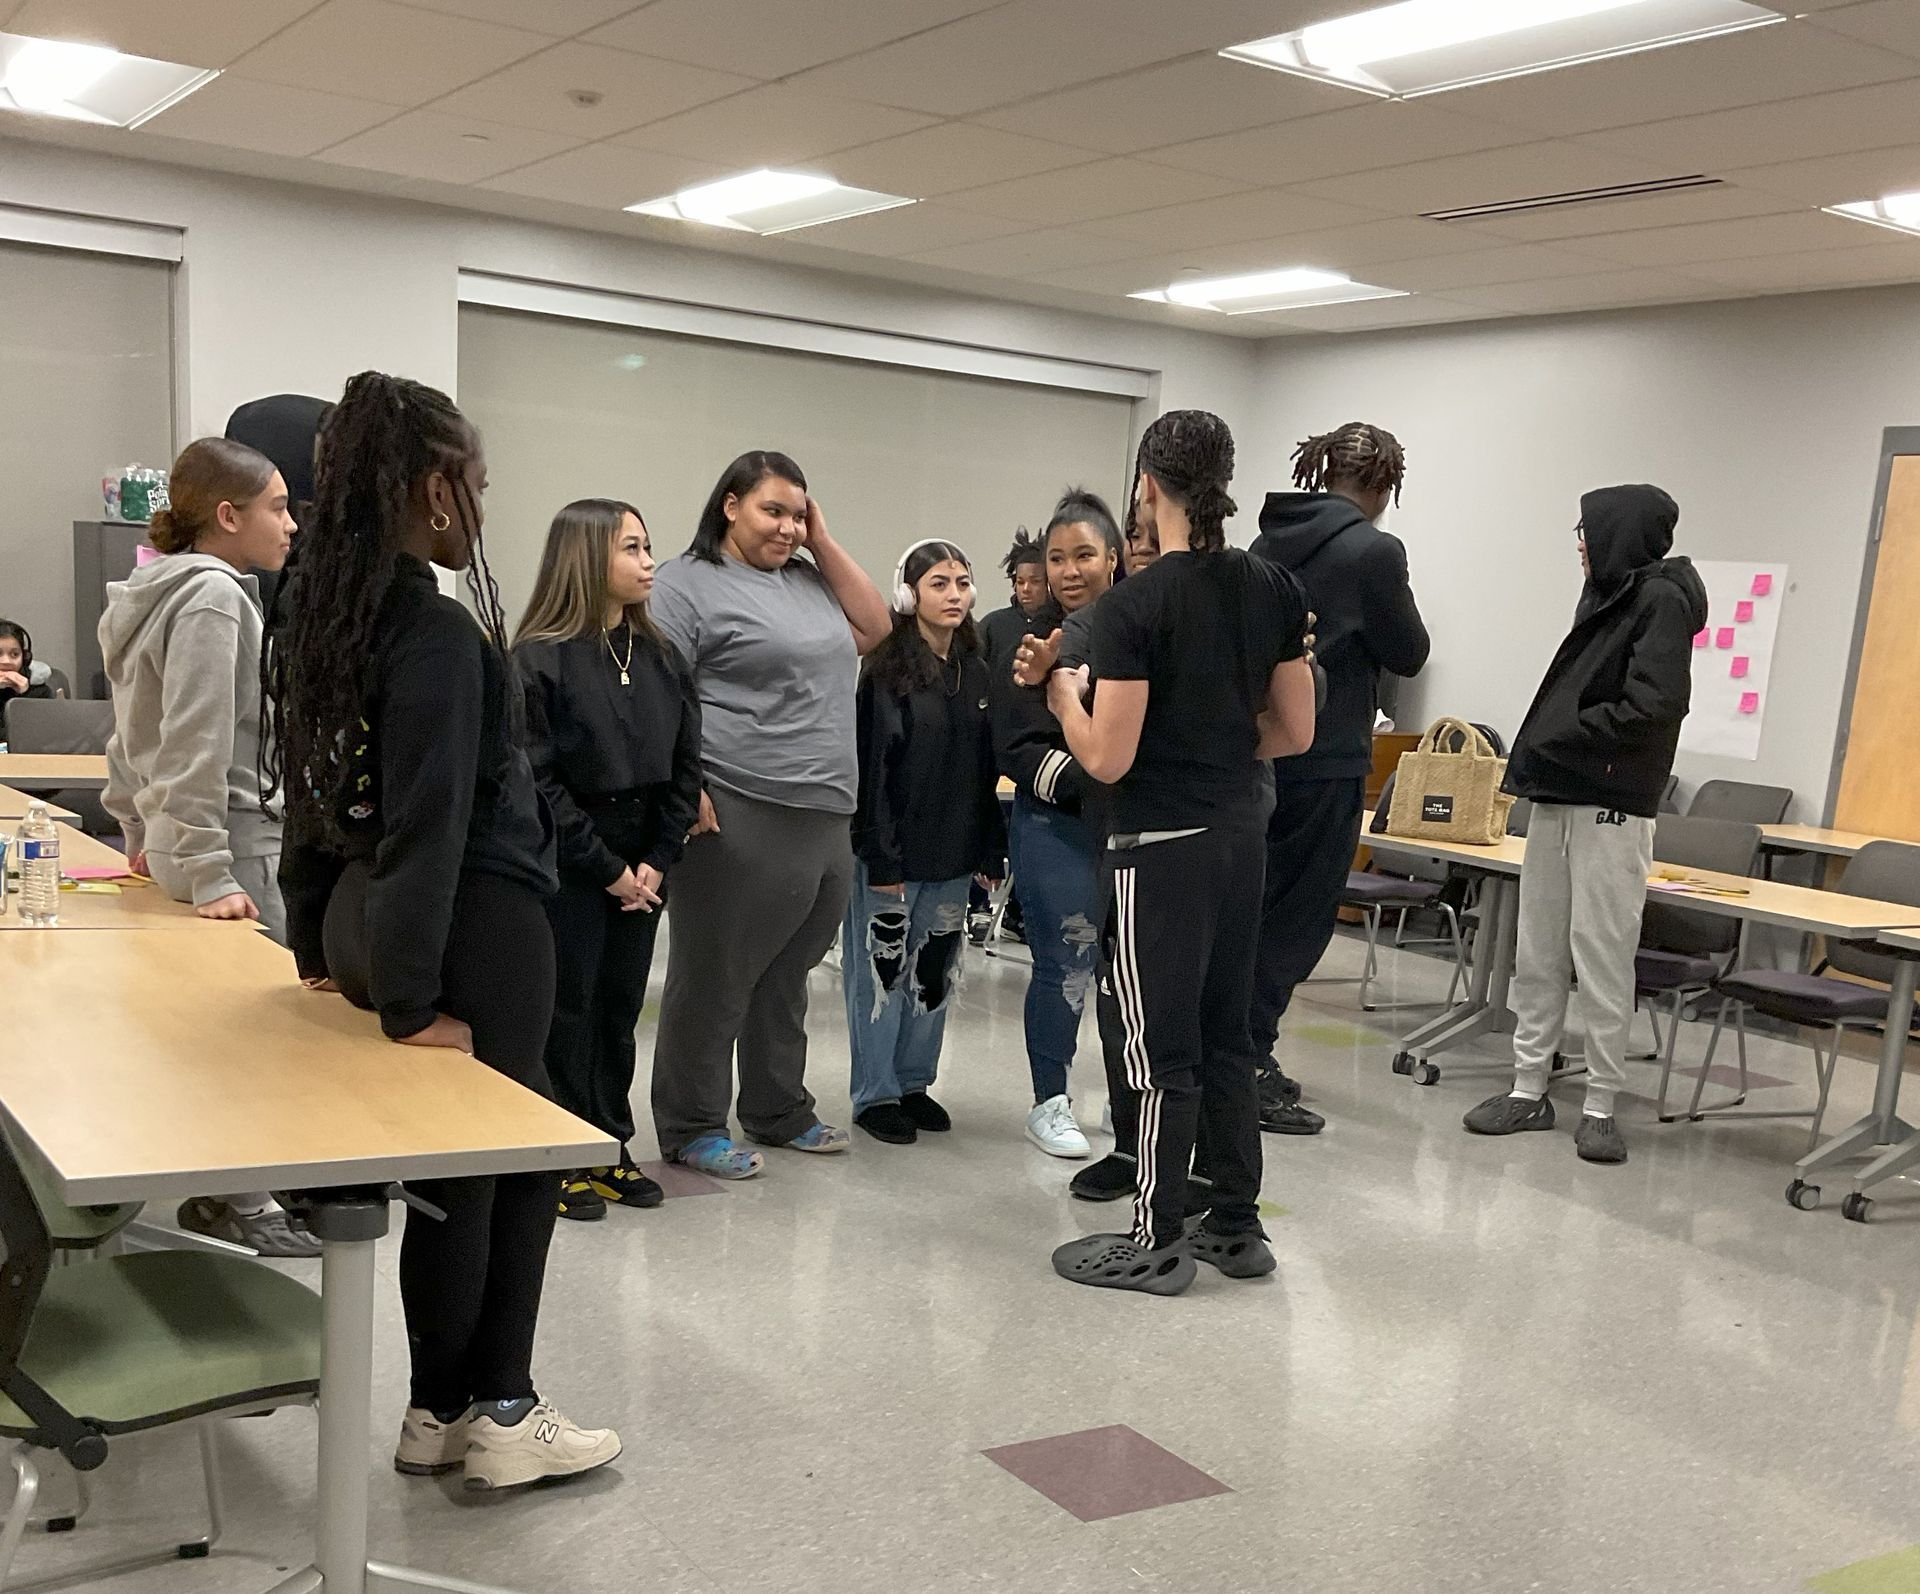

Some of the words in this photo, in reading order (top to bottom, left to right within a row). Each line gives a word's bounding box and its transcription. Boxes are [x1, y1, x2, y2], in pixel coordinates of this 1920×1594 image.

[147, 487, 169, 500] Pola
[1596, 810, 1627, 826] GAP
[535, 1420, 559, 1444] N
